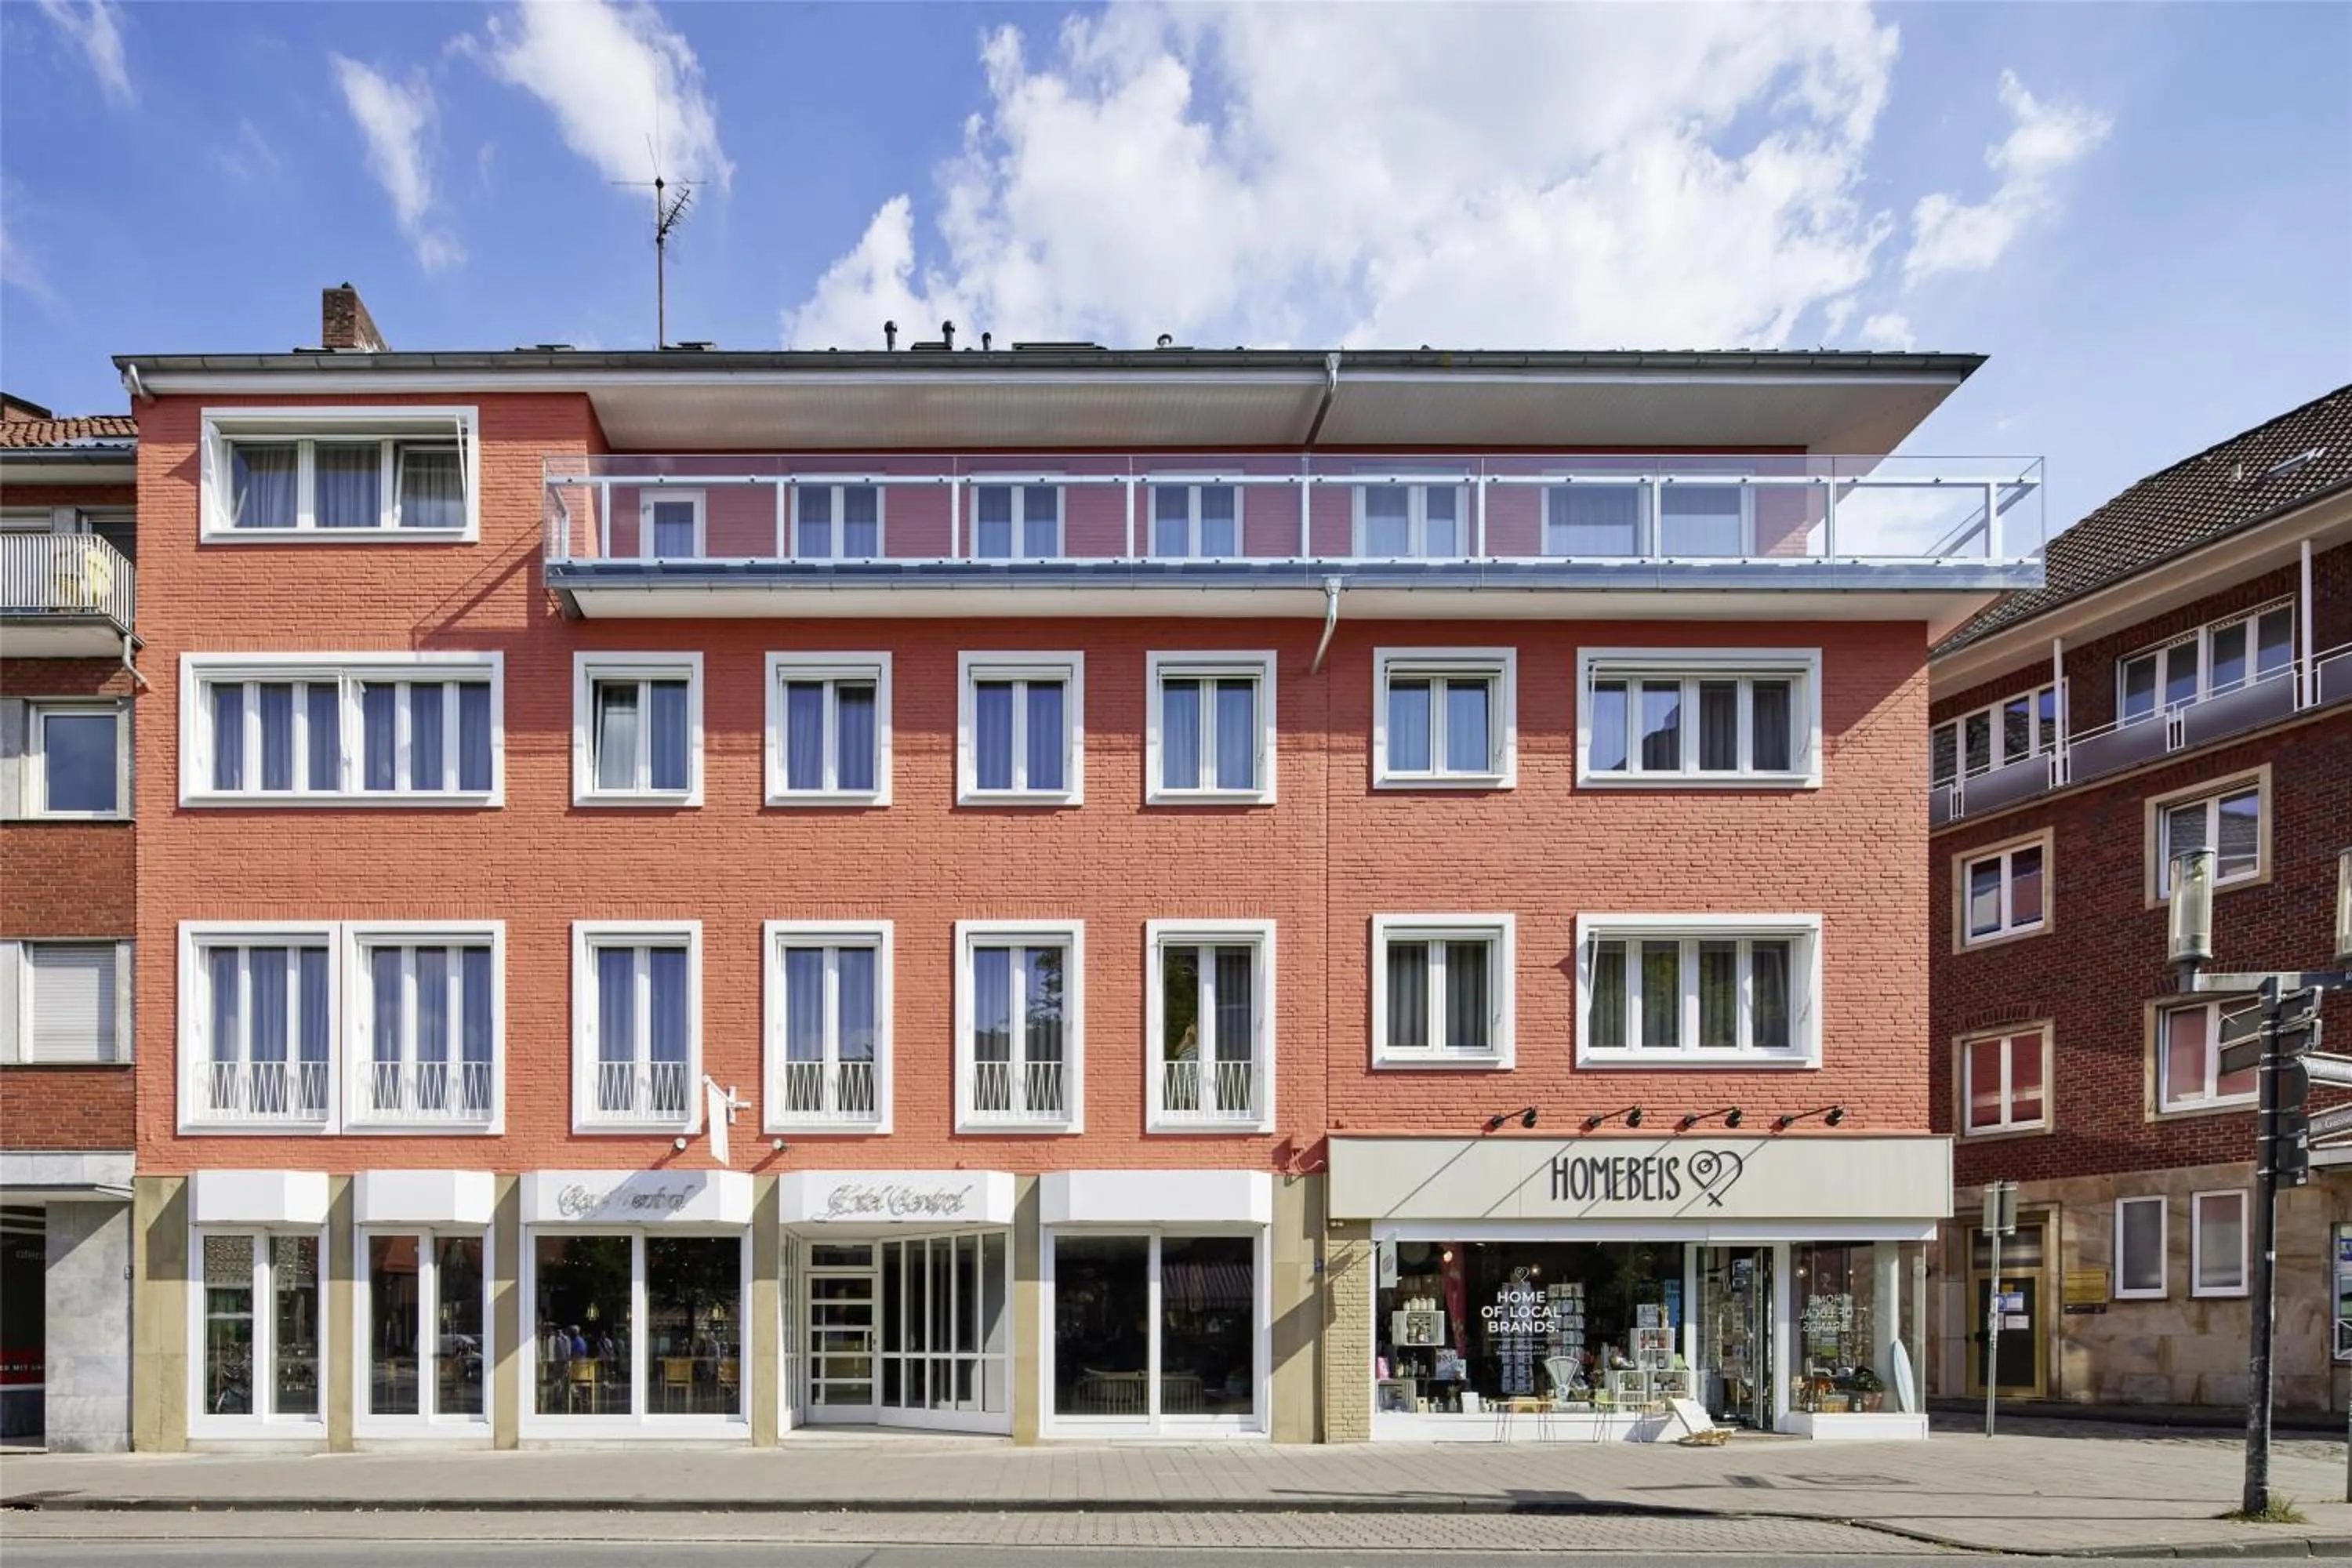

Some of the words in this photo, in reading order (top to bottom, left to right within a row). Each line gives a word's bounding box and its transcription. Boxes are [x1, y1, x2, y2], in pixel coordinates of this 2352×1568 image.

[1552, 1156, 1681, 1201] HOMEBEIS
[1497, 1291, 1546, 1304] HOME
[1481, 1305, 1504, 1318] OF
[1509, 1305, 1563, 1318] LOCAL
[1487, 1321, 1559, 1333] BRANDS.
